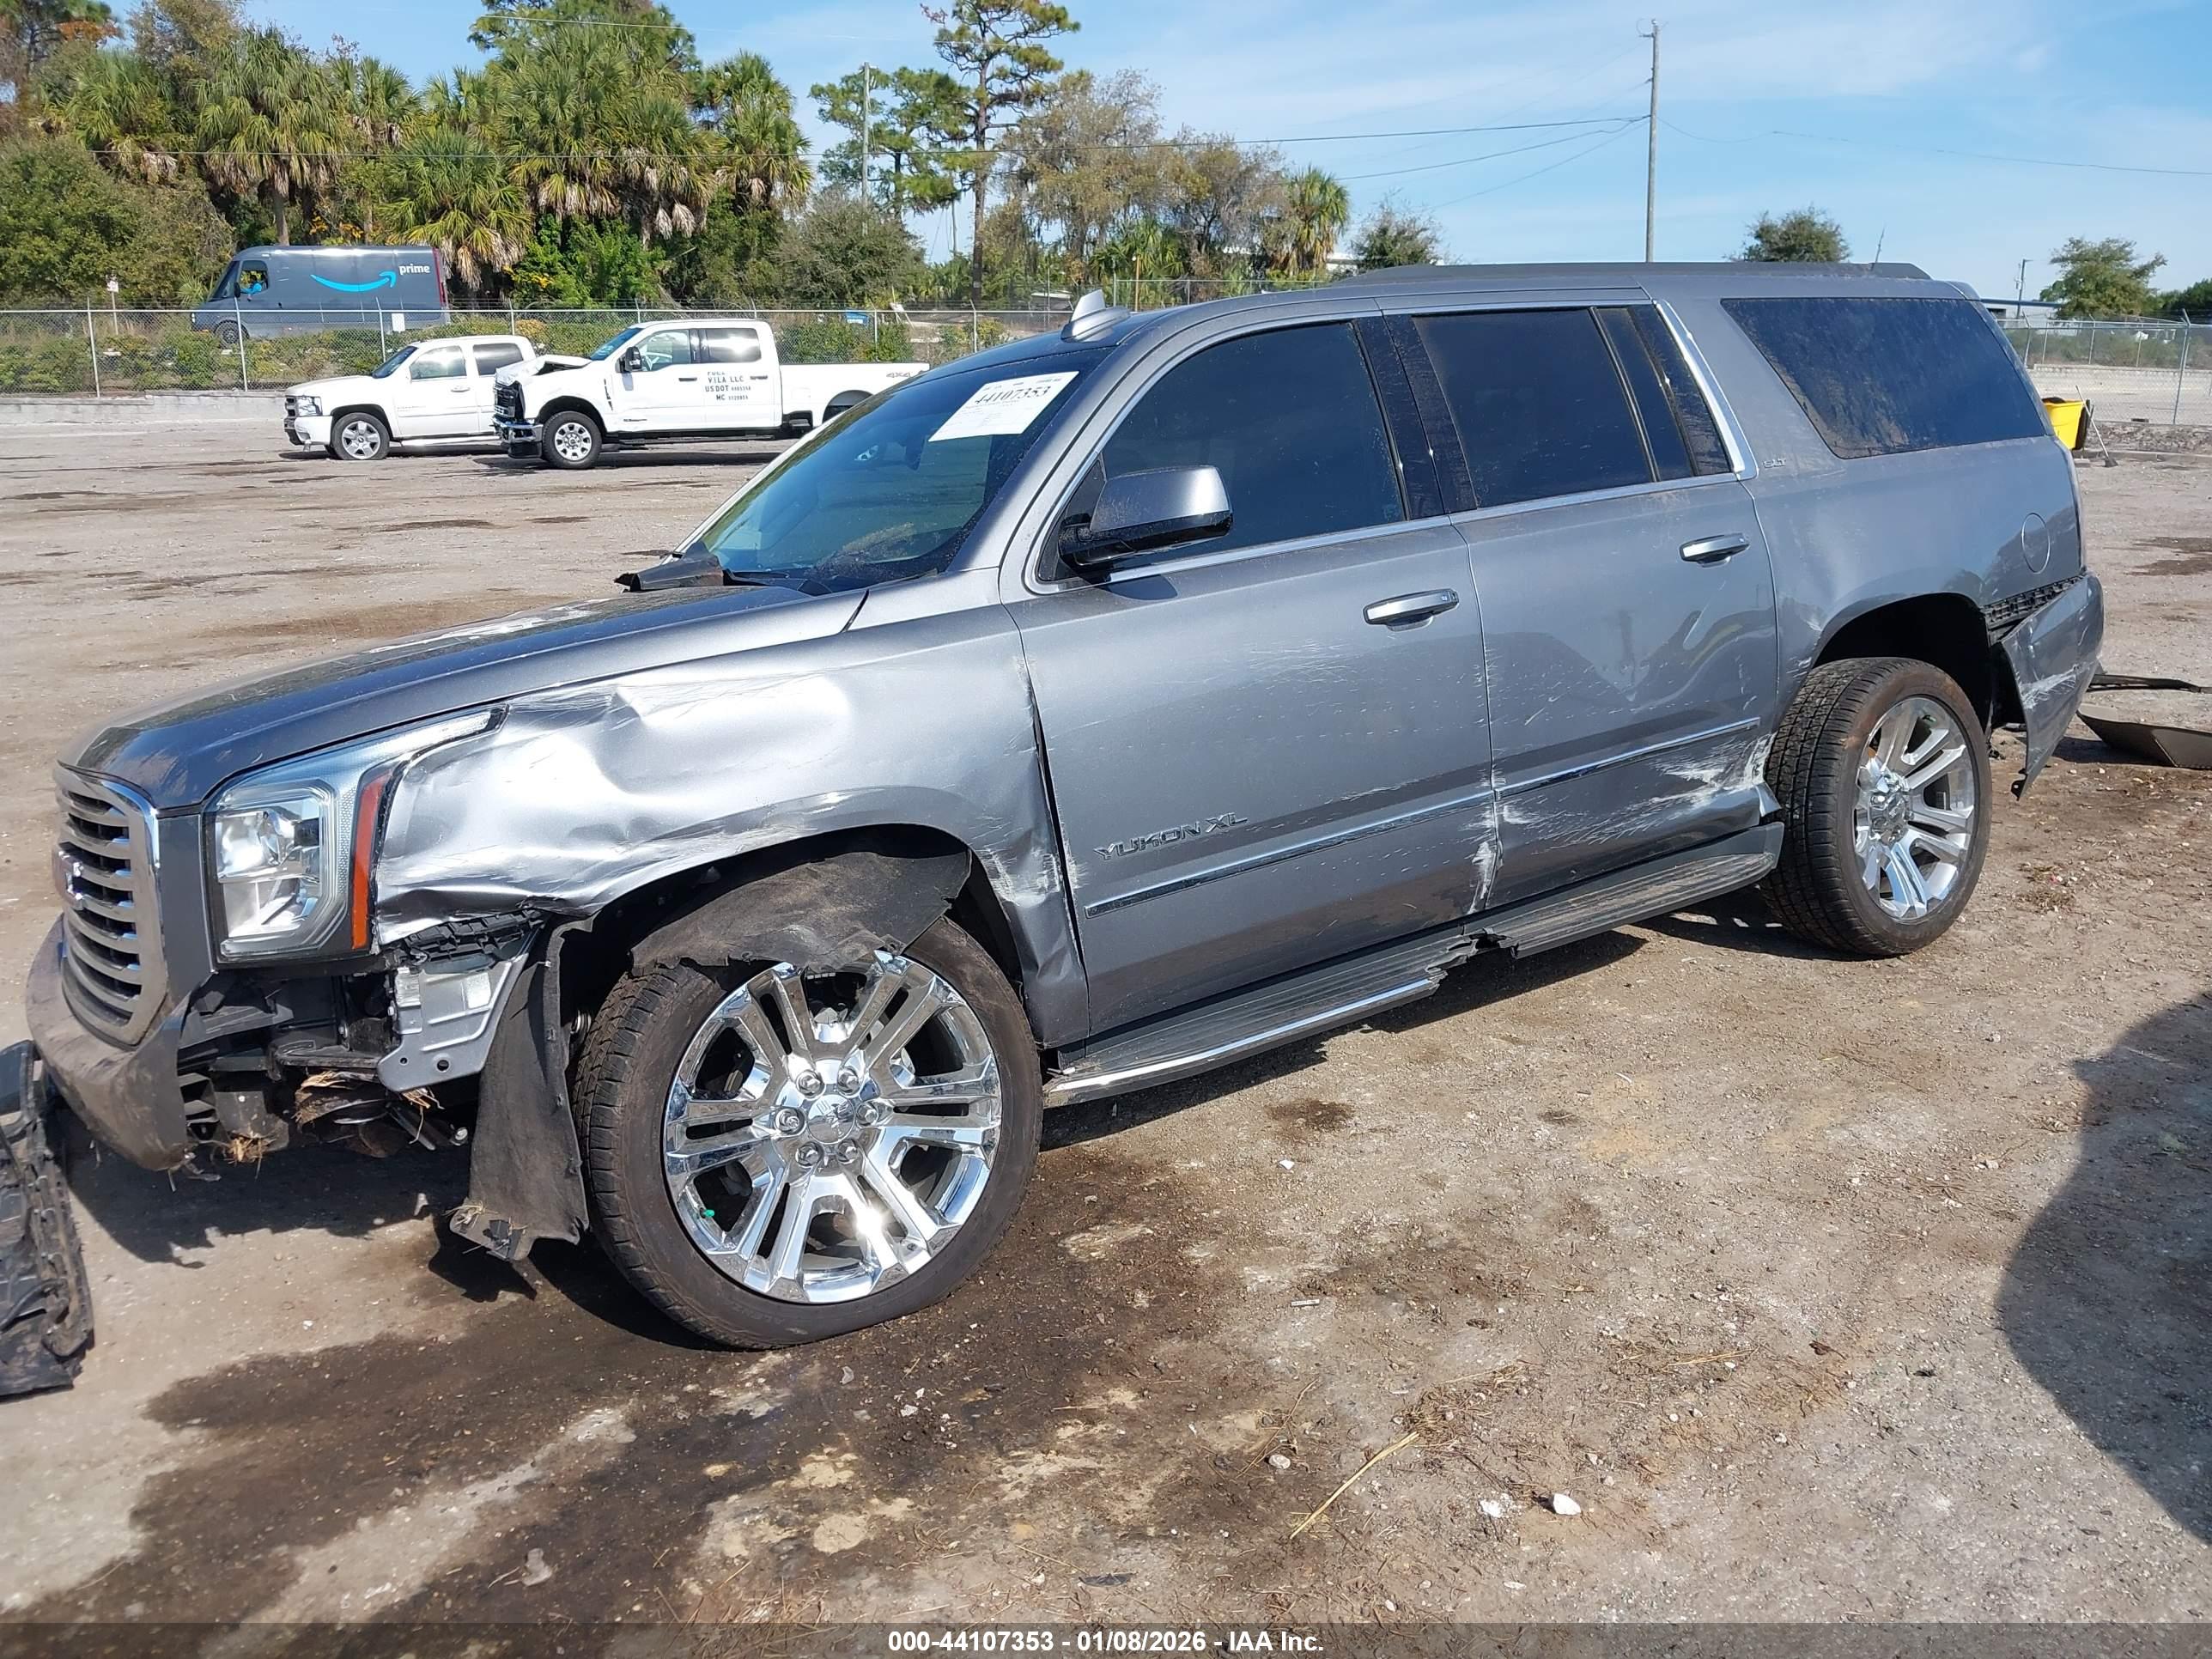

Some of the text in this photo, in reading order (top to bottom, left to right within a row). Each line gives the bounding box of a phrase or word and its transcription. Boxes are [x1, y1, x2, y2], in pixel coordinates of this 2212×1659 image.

[398, 263, 430, 276] prime
[975, 386, 1052, 404] 44107353
[1762, 458, 1786, 470] SLT
[1093, 811, 1249, 860] YUKON XL
